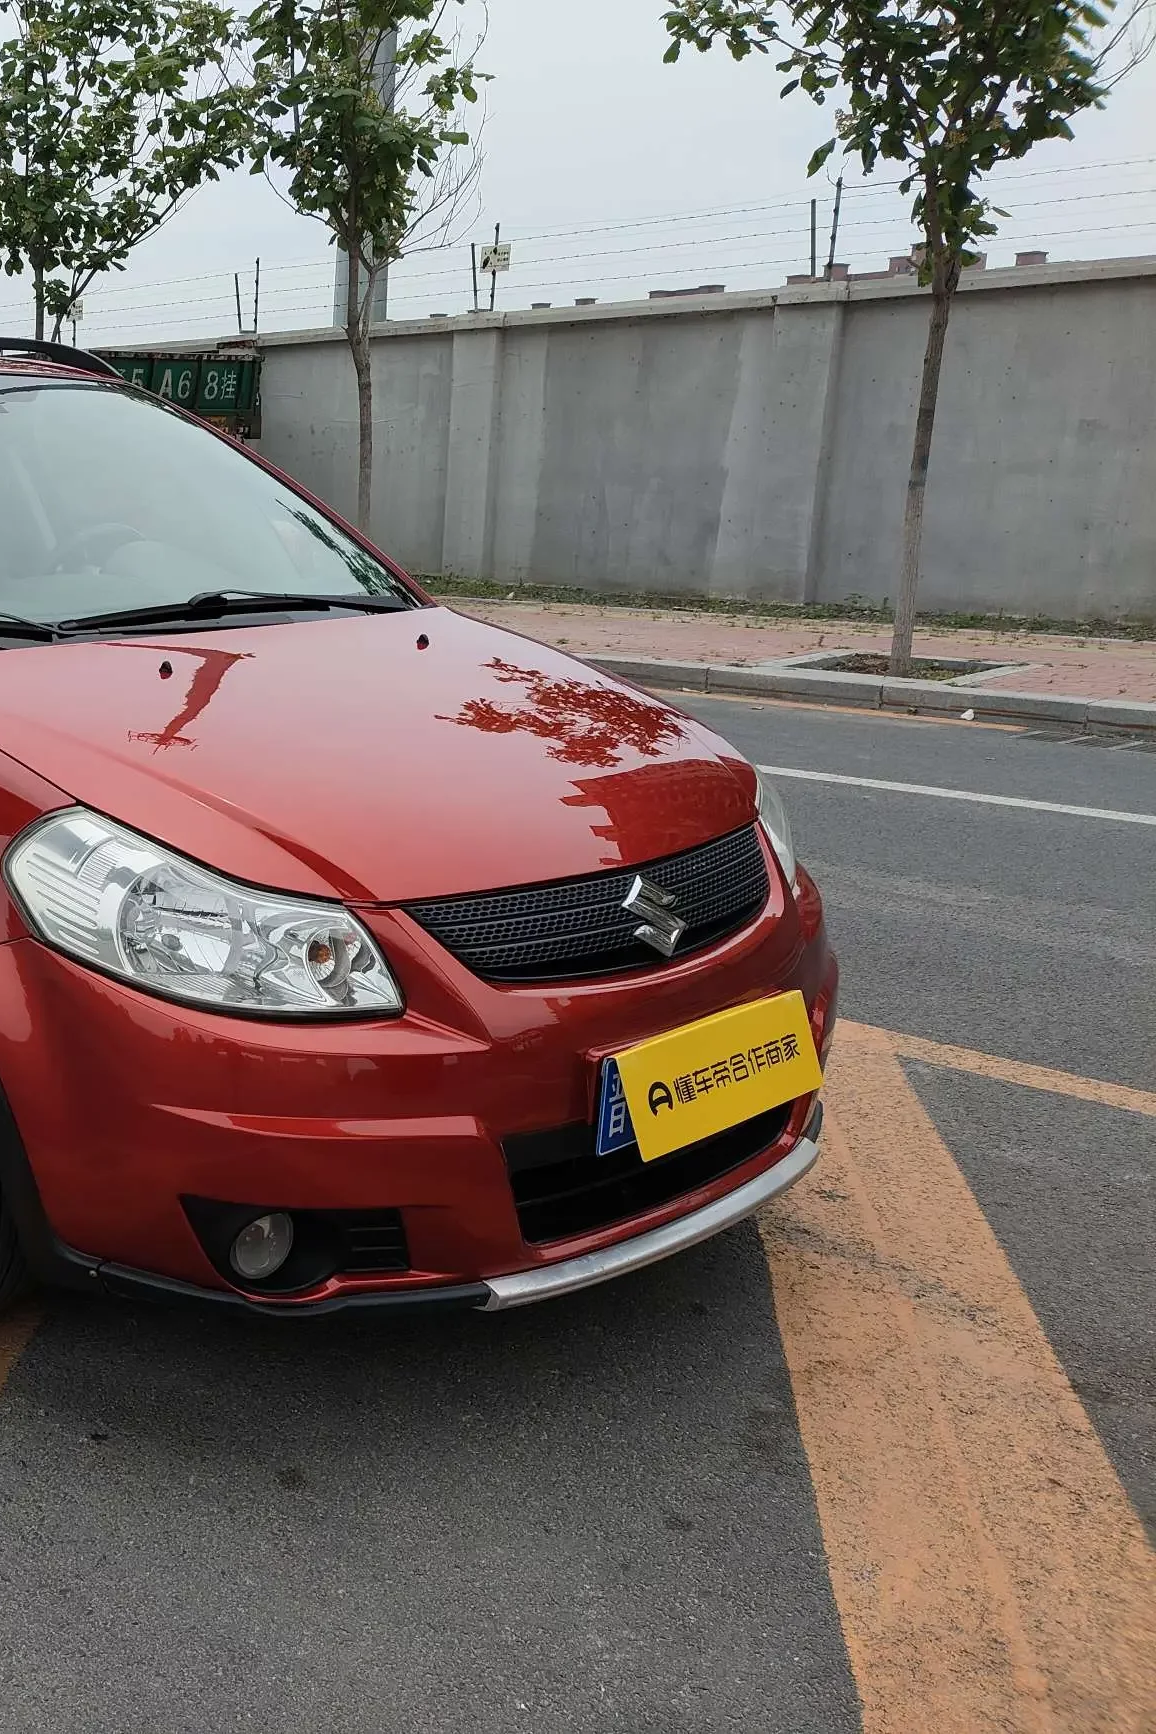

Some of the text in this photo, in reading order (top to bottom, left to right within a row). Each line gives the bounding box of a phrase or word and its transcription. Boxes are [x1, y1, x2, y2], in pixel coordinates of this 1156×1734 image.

[673, 1033, 801, 1105] 懂车帝合作商家
